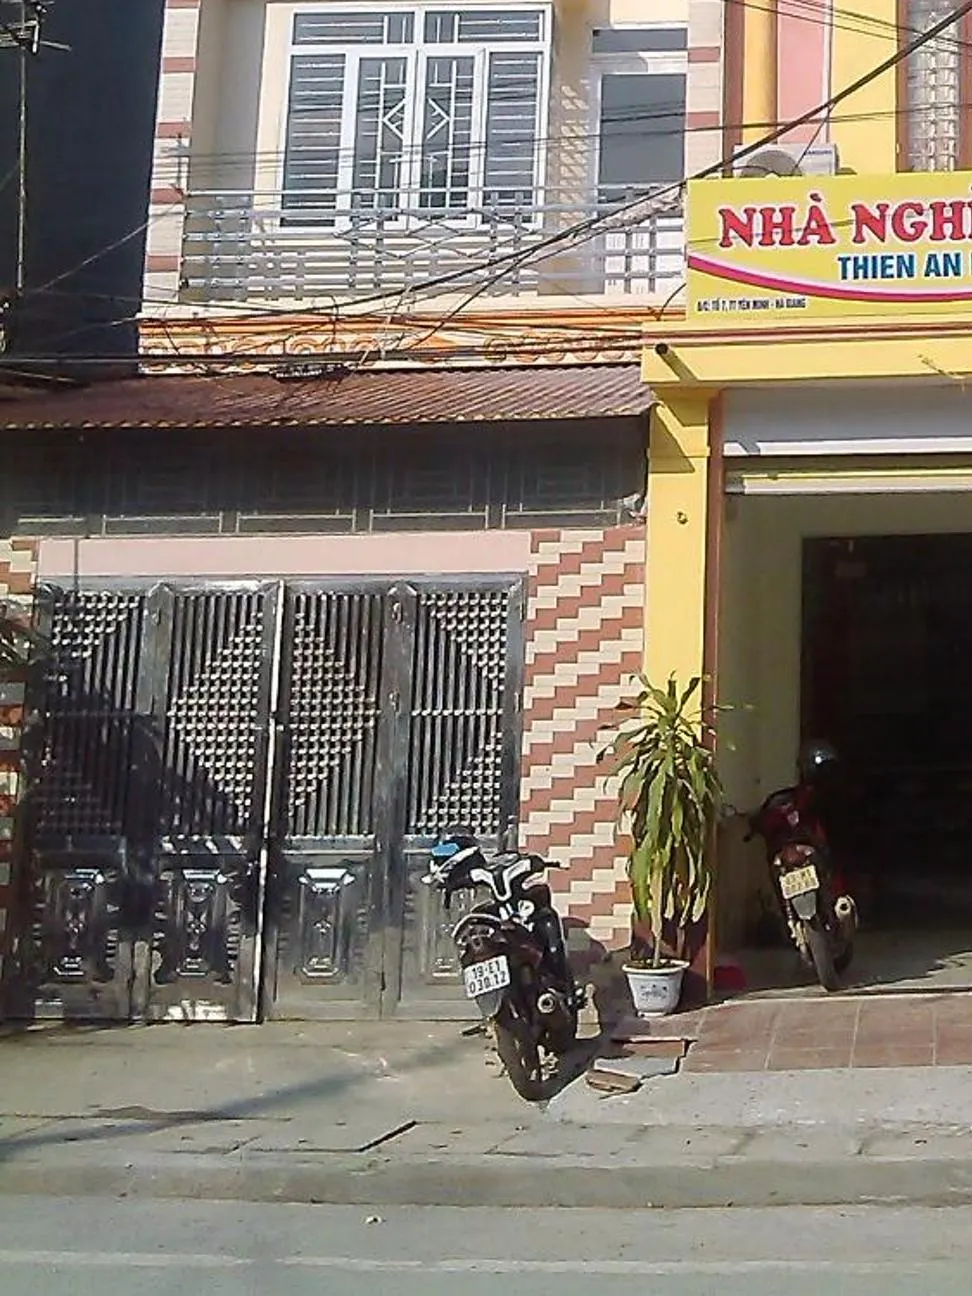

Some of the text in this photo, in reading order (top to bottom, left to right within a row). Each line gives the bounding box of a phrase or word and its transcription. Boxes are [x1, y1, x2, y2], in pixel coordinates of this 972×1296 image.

[719, 193, 836, 248] NHÀ
[837, 254, 915, 281] THIEN
[924, 253, 962, 278] AN
